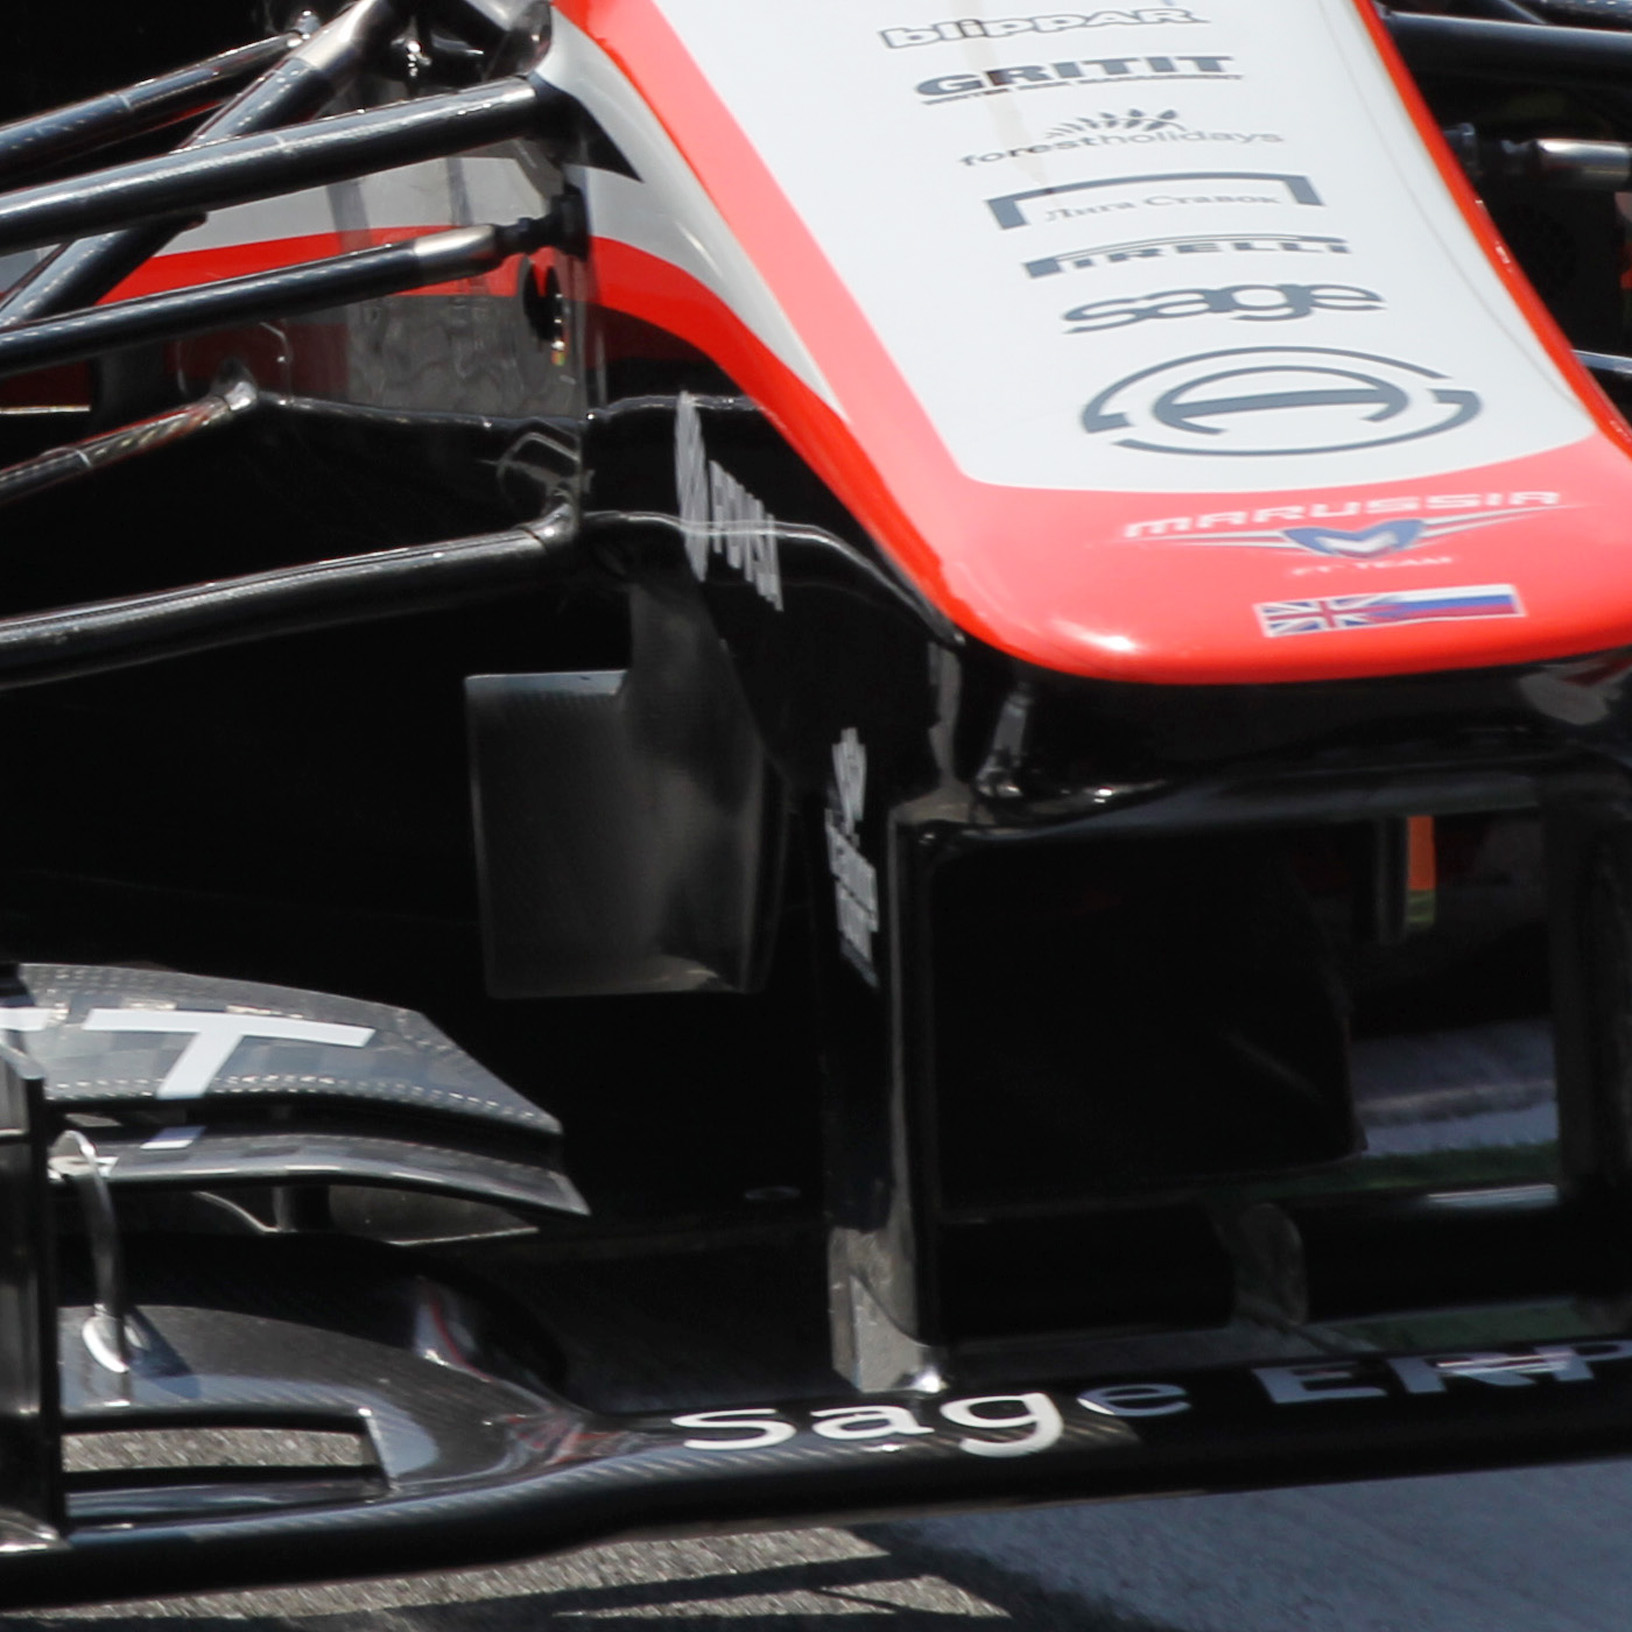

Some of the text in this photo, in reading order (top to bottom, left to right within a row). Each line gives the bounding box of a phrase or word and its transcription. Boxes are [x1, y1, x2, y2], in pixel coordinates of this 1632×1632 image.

[914, 55, 1236, 97] GRITIT
[1021, 232, 1352, 280] PIRELLI
[1061, 283, 1389, 335] sage
[1122, 490, 1562, 539] MARUSSIA
[671, 1382, 1194, 1459] sage
